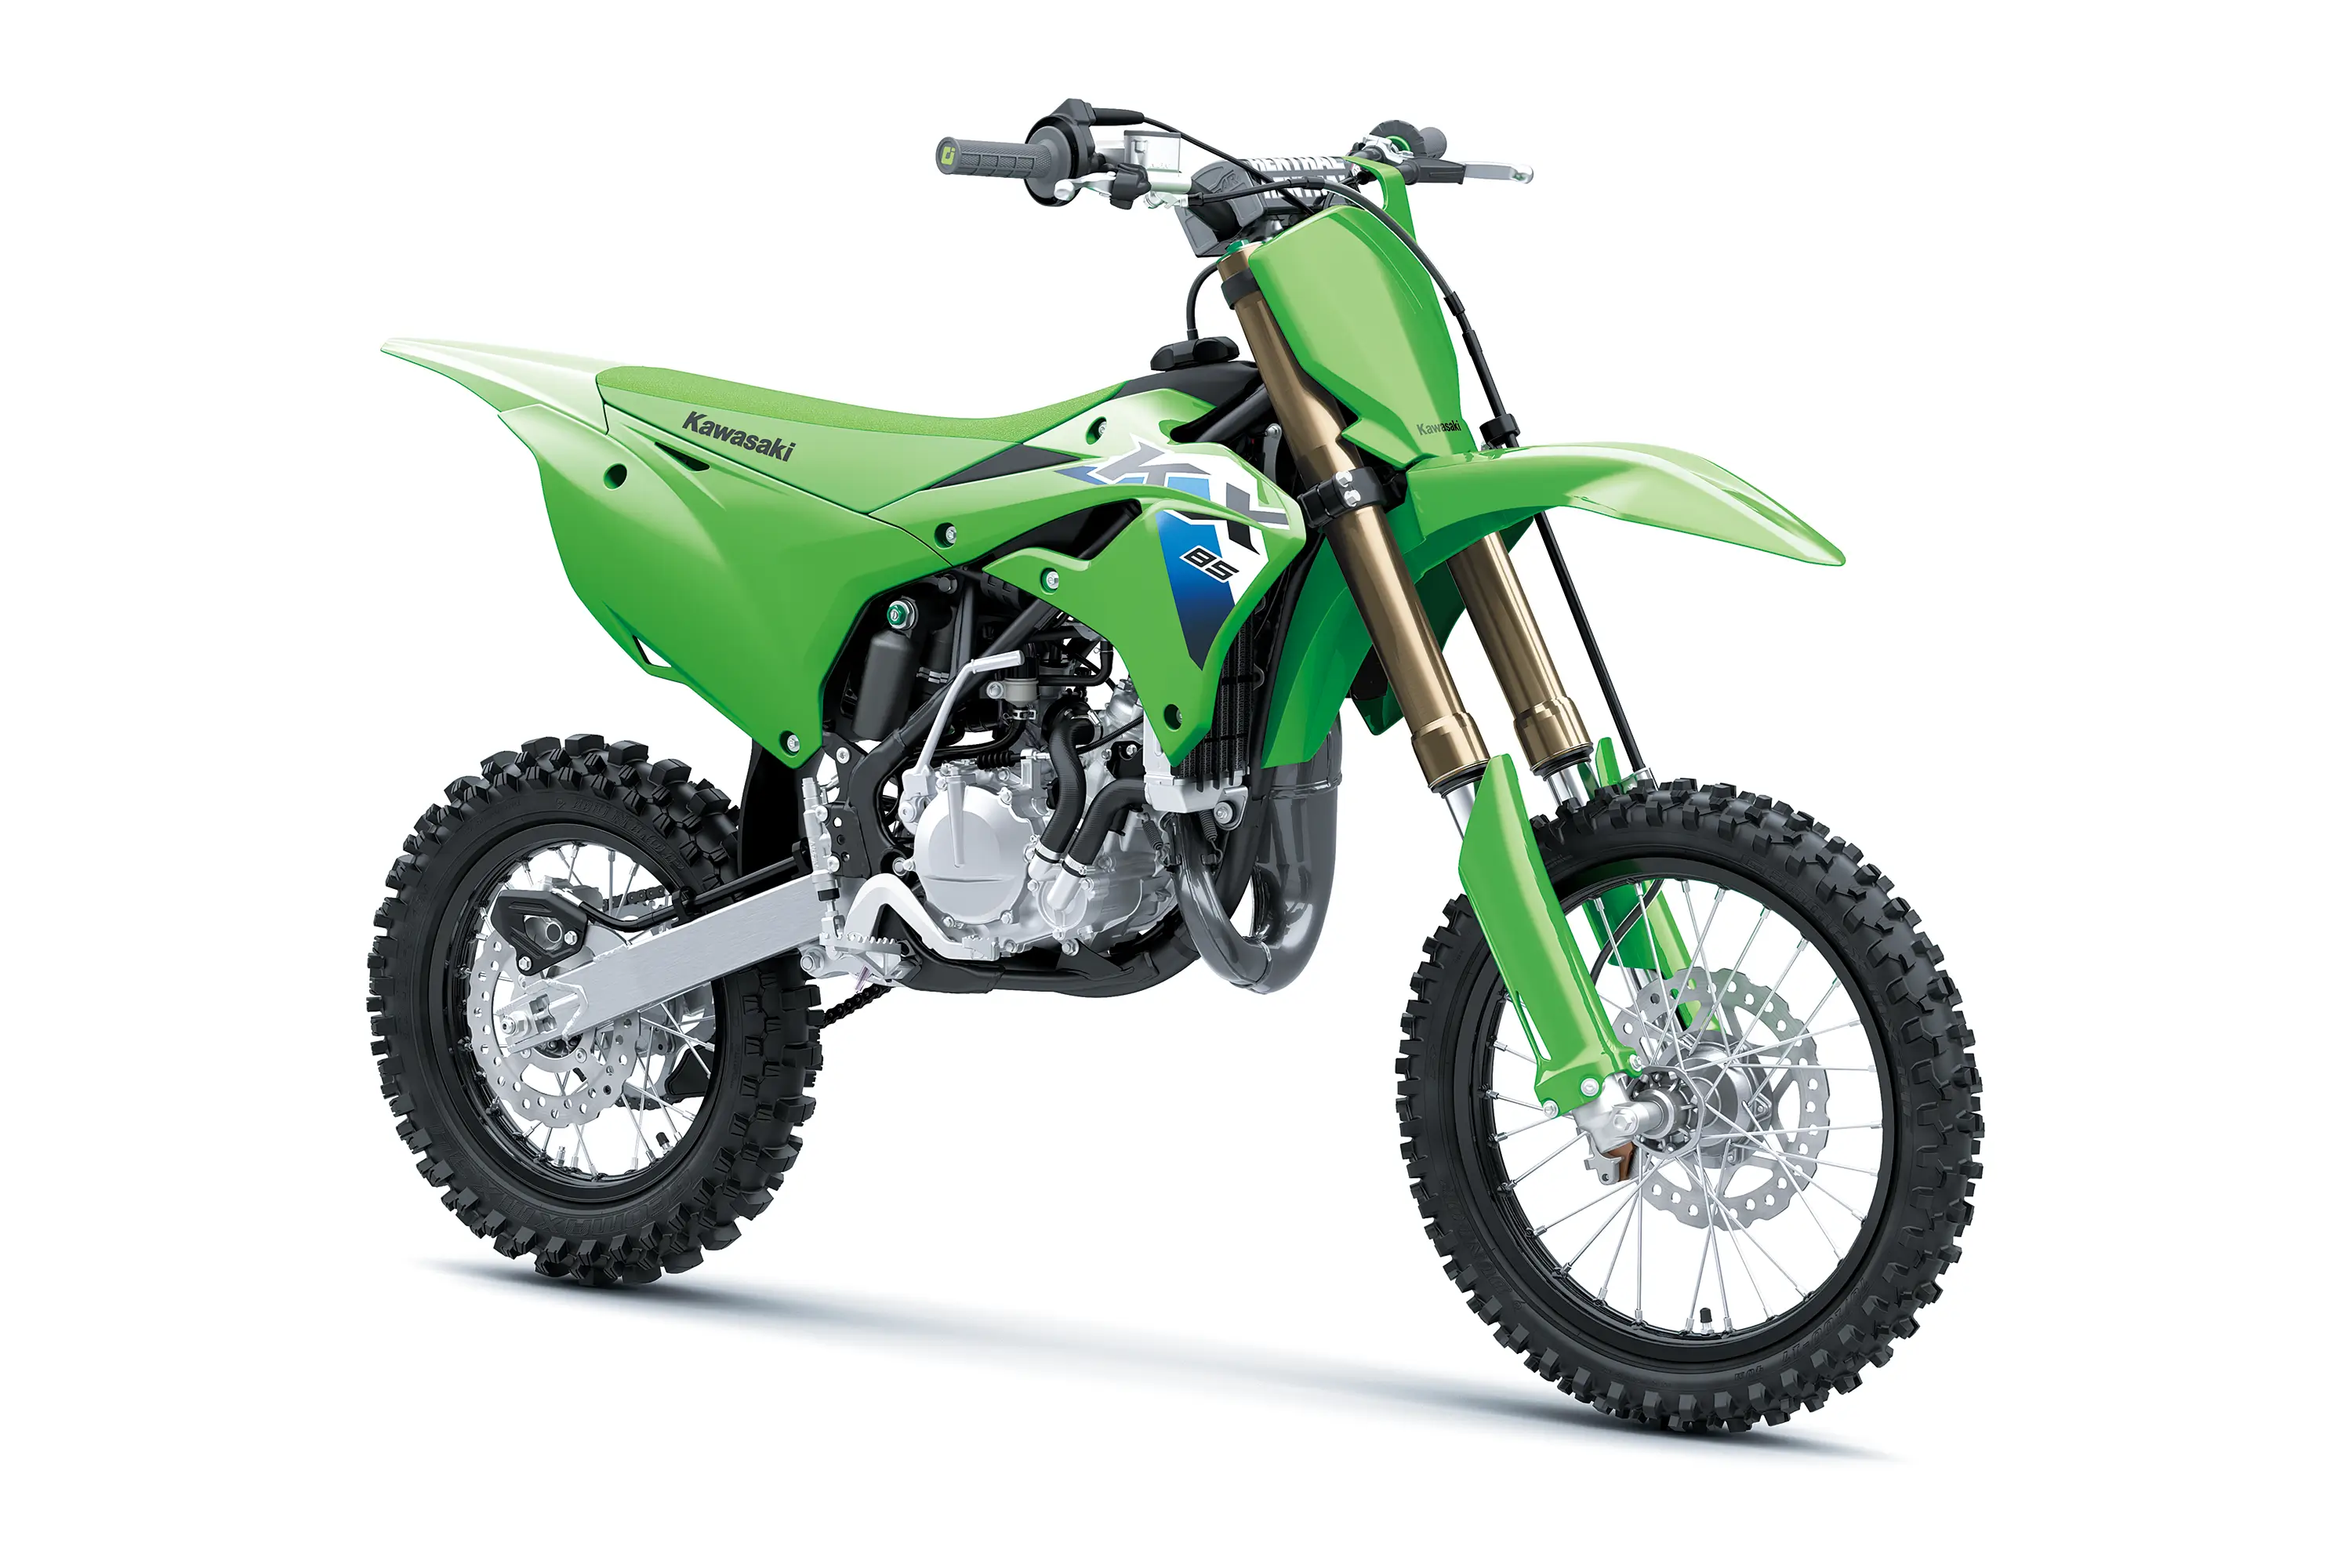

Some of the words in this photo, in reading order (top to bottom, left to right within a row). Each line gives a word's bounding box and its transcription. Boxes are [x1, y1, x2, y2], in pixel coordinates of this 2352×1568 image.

[682, 411, 797, 462] Kawasaki
[1416, 419, 1461, 436] Kawasaki
[1182, 547, 1240, 582] 85
